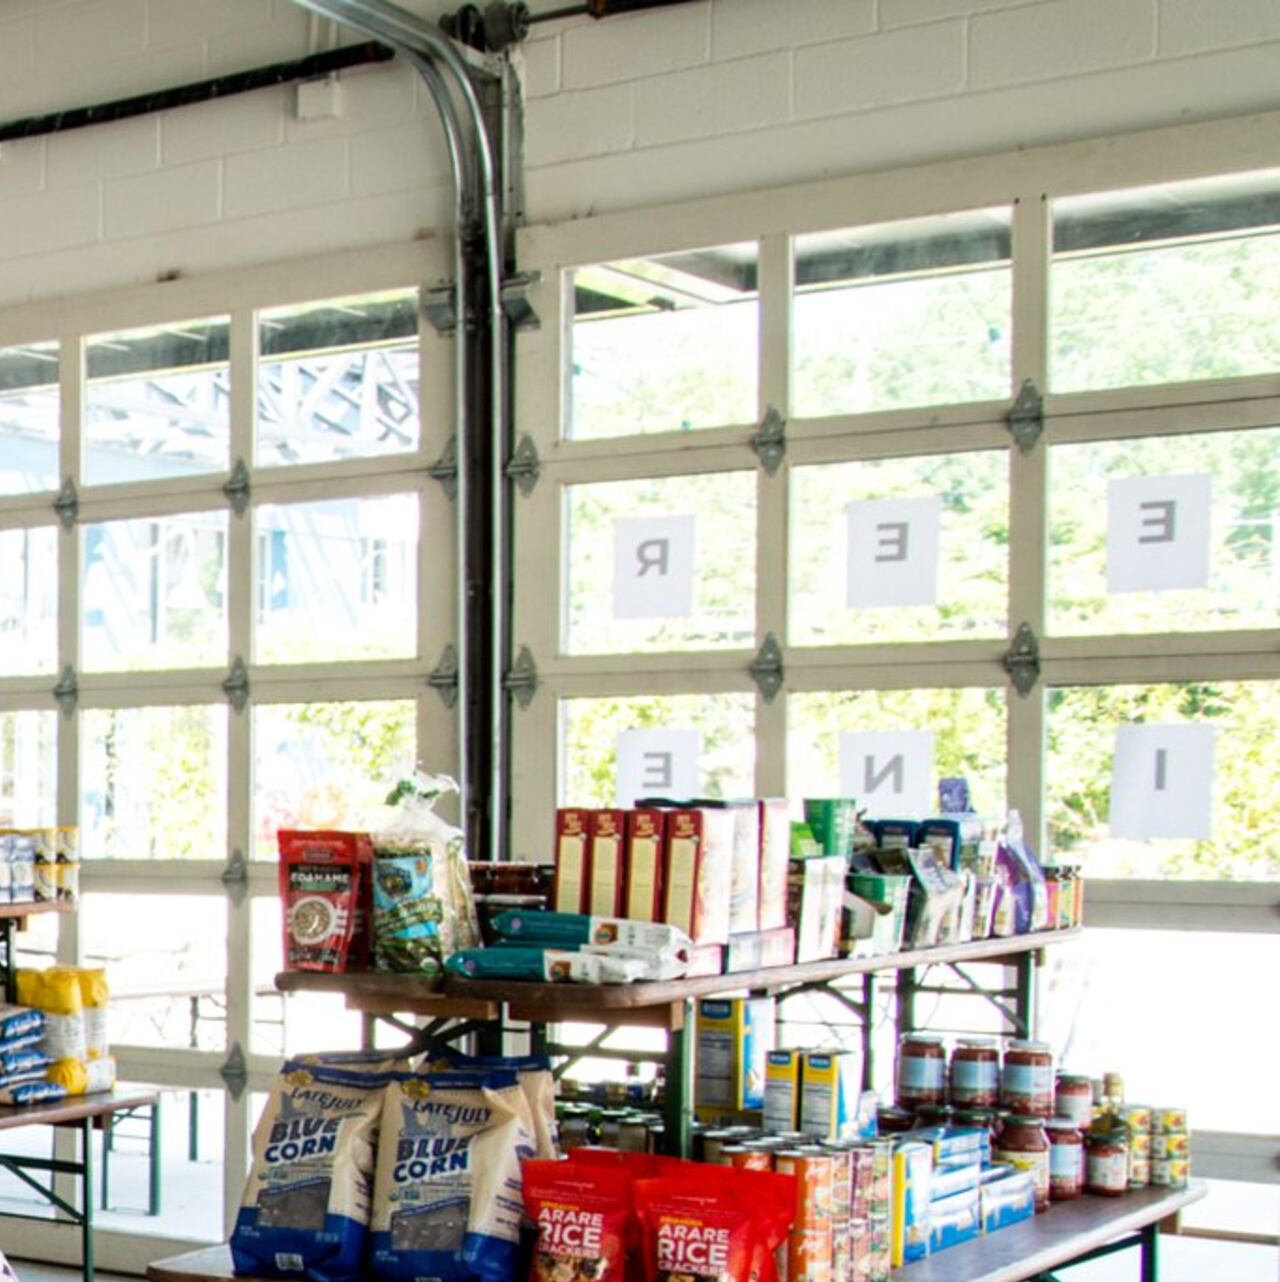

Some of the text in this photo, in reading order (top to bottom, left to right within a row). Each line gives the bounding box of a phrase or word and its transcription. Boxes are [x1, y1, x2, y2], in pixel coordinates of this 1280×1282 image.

[269, 1117, 340, 1144] BLUE
[264, 1135, 337, 1165] CORN
[395, 1134, 476, 1163] BLUE
[392, 1150, 471, 1184] CORN
[538, 1207, 604, 1227] ARARE
[538, 1221, 602, 1249] RICE
[658, 1223, 730, 1244] ARARE
[657, 1239, 728, 1267] RICE
